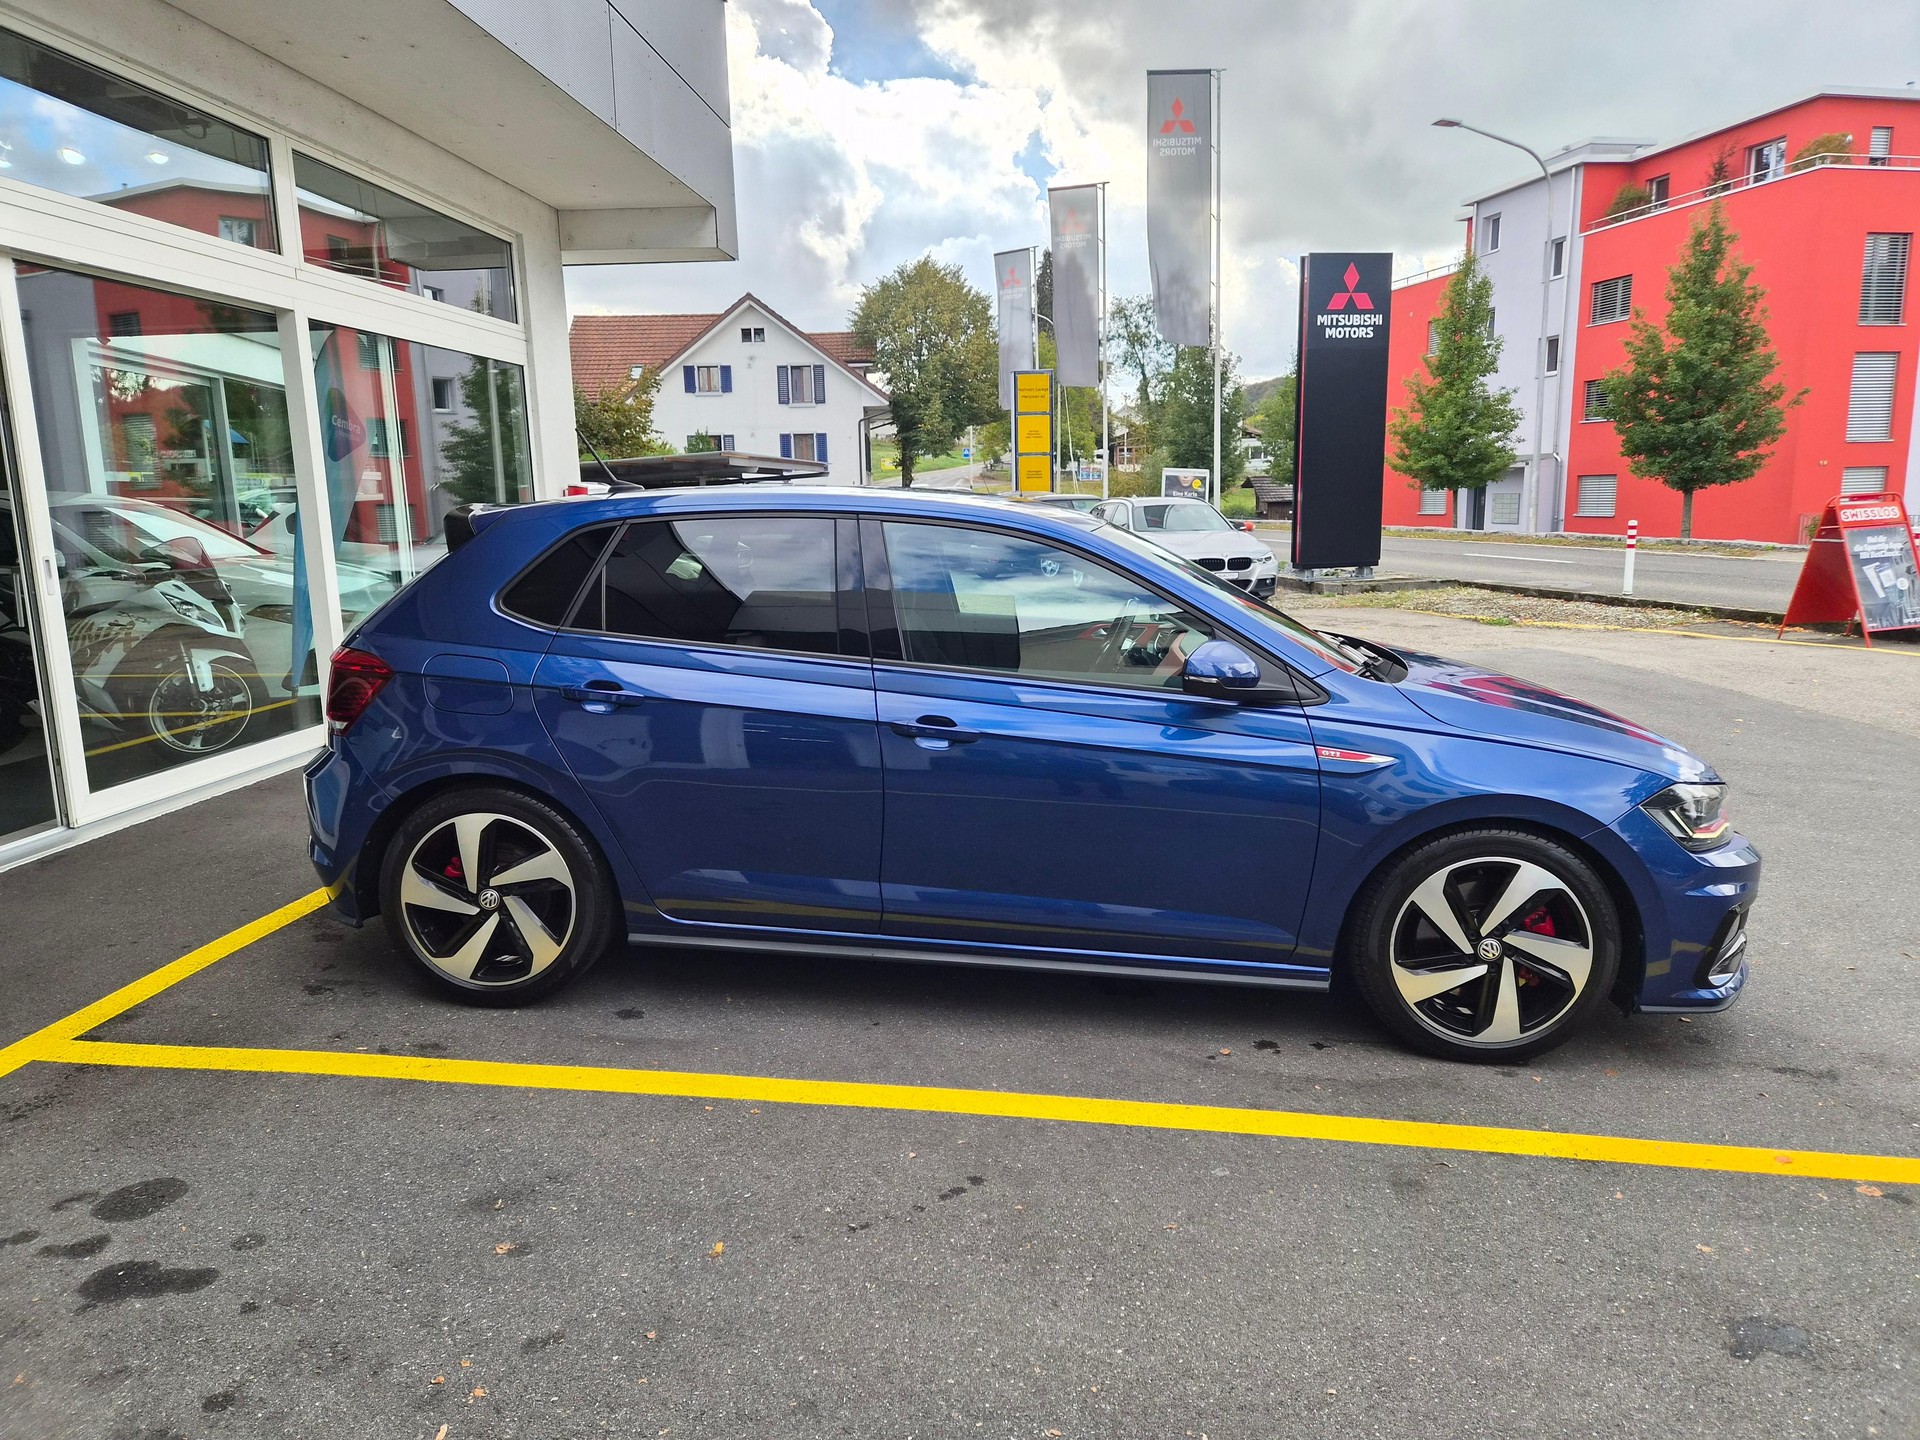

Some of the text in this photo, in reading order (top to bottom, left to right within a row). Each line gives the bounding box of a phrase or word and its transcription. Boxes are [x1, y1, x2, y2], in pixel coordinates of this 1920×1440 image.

[1317, 314, 1383, 326] MITSUBISHI
[1325, 326, 1374, 339] MOTORS
[332, 414, 361, 435] Cembra
[1842, 507, 1898, 520] SWISSLOS
[1321, 750, 1341, 758] GTI
